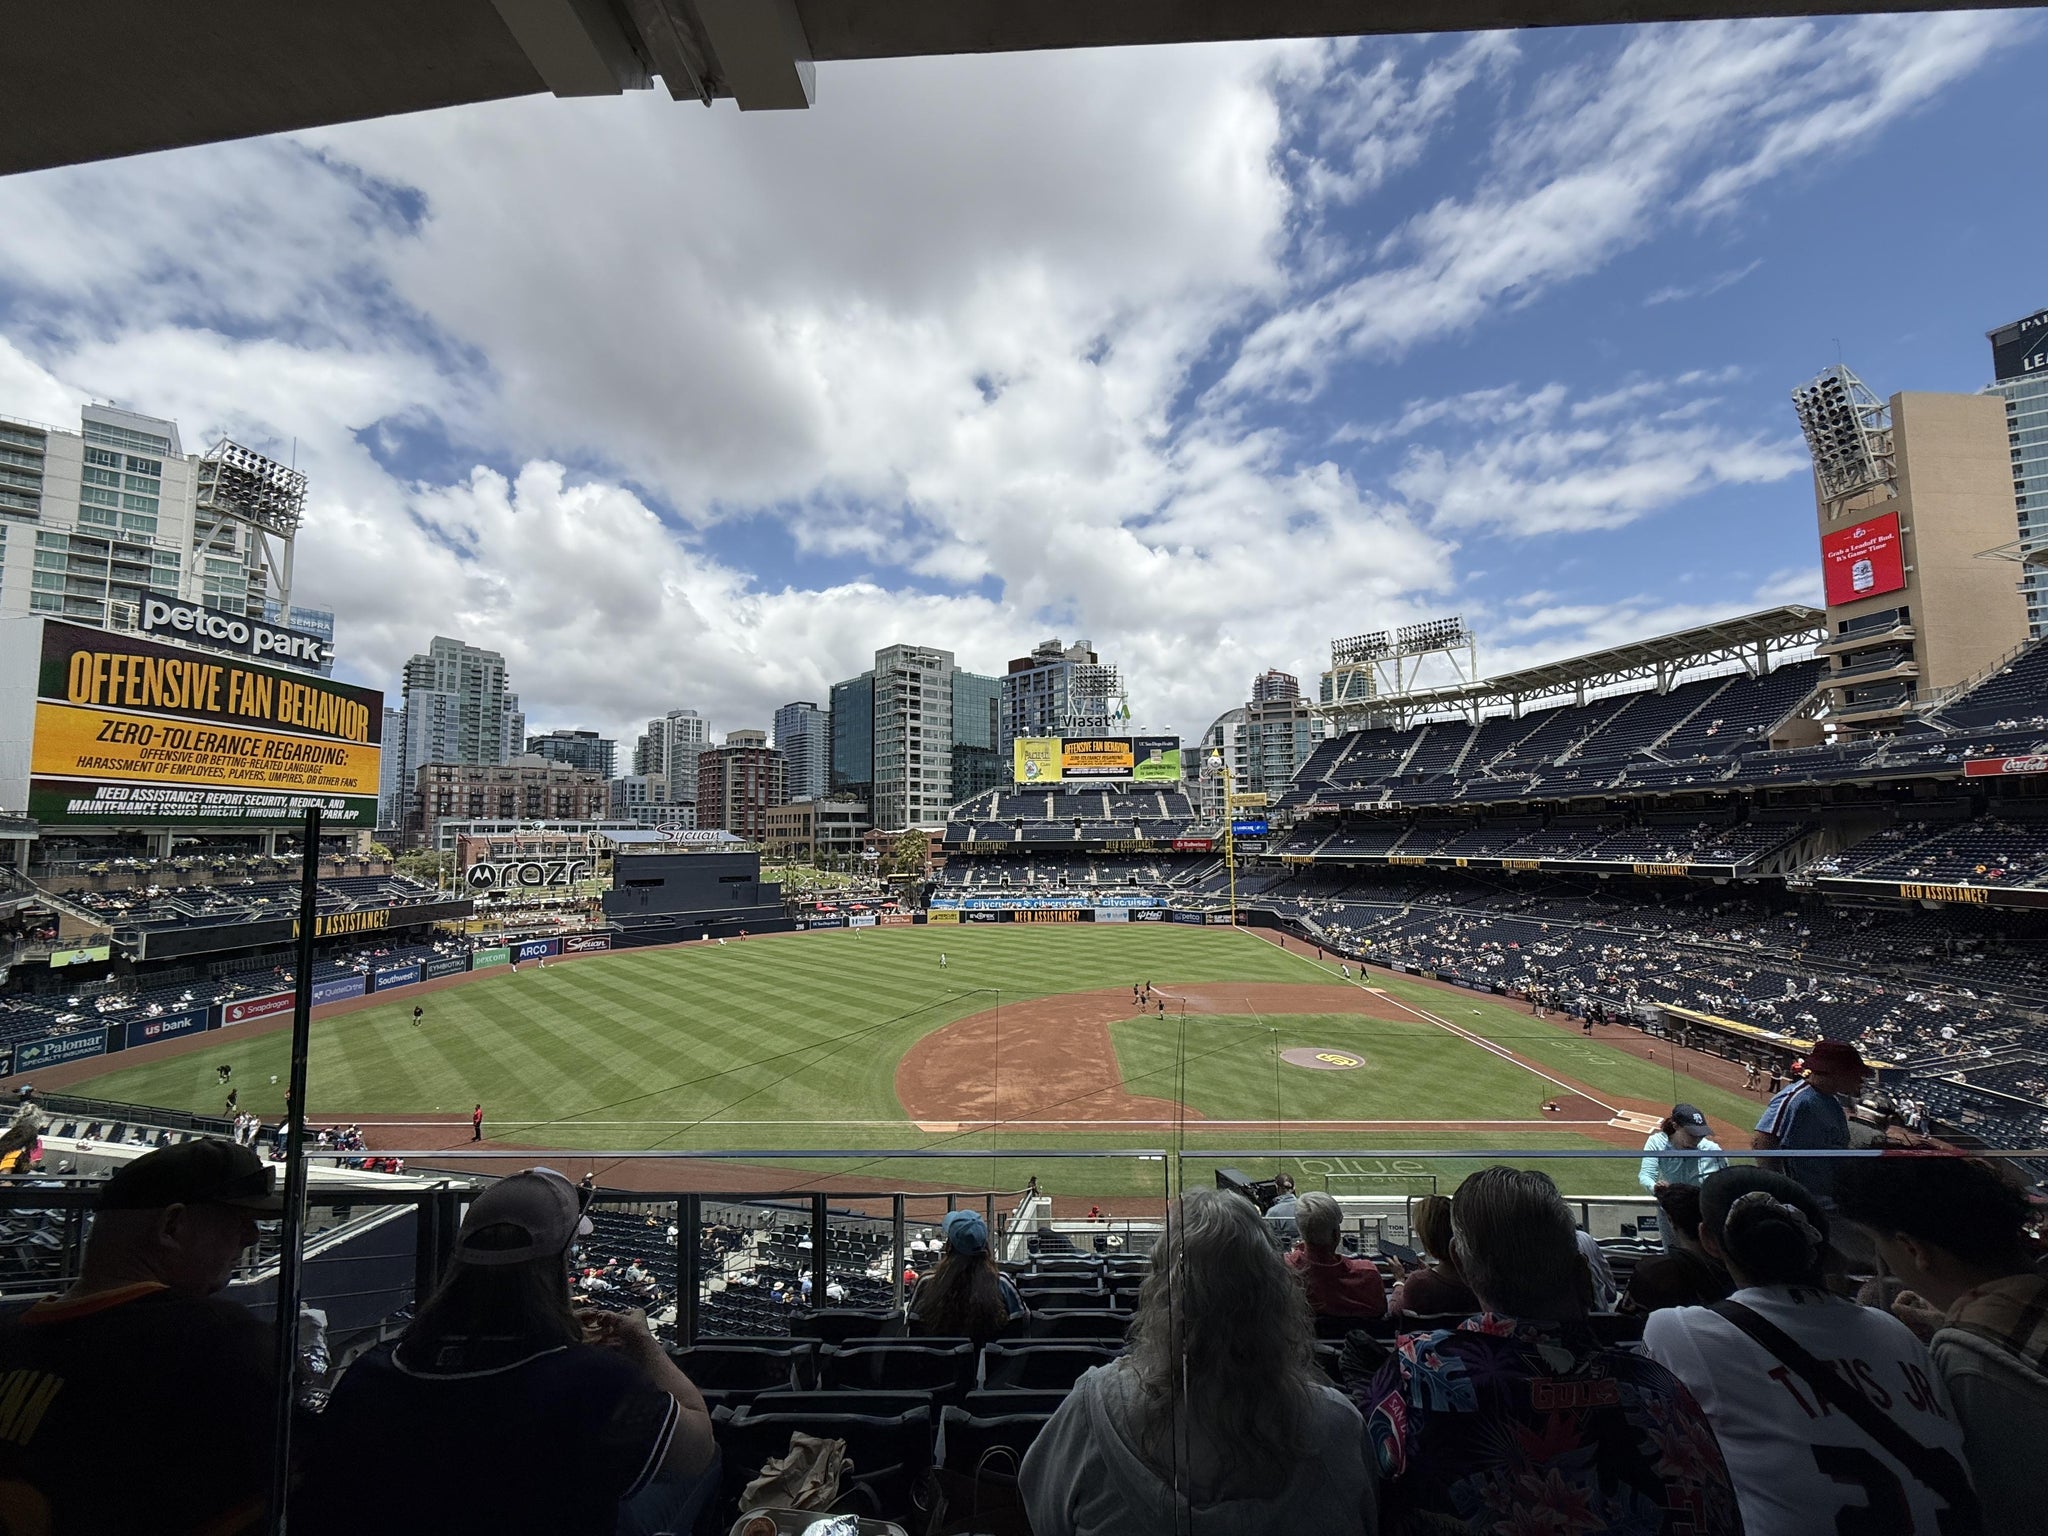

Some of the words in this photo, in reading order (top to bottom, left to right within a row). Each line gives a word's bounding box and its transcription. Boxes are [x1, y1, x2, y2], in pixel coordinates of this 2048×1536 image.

[1828, 549, 1844, 558] Grab
[1850, 537, 1877, 551] Leadoff
[1847, 549, 1868, 559] Game
[143, 599, 249, 644] petco
[252, 627, 321, 662] park
[290, 617, 331, 631] SEMPRA
[68, 650, 224, 712] OFFENSIVE
[228, 668, 273, 720] FAN
[278, 679, 369, 743] BEHAVIOR
[1062, 714, 1111, 728] Viasat
[96, 719, 262, 757] ZERO-TOLERANCE
[263, 740, 349, 766] REGARDING:
[1064, 740, 1092, 755] OFFENSIVE
[139, 748, 195, 763] OFFENSIVE
[195, 753, 209, 764] OR
[210, 754, 284, 771] BETTING-RELATED
[284, 761, 324, 774] LANGUAGE
[76, 756, 155, 773] HARASSMENT
[155, 762, 169, 774] OF
[170, 763, 227, 779] EMPLOYEES,
[229, 769, 266, 782] PLAYERS,
[268, 771, 305, 785] UMPIRES,
[306, 774, 317, 784] OR
[317, 775, 340, 787] OTHER
[340, 777, 358, 788] FANS
[95, 786, 130, 800] NEED
[130, 788, 205, 804] ASSISTANCE?
[205, 792, 245, 806] REPORT
[244, 793, 289, 808] SECURITY,
[289, 796, 327, 809] MEDICAL,
[328, 799, 346, 809] AND
[67, 800, 157, 816] MAINTENANCE
[157, 802, 198, 816] ISSUES
[198, 804, 244, 818] DIRECTLY
[245, 806, 286, 818] THROUGH
[287, 808, 302, 818] THE
[343, 810, 360, 820] APP
[655, 821, 720, 847] Sycuan
[499, 861, 587, 888] razr
[1633, 864, 1647, 874] NEED
[1648, 864, 1689, 876] ASSISTANCE?
[1900, 883, 1922, 899] NEED
[1925, 885, 1988, 903] ASSISTANCE?
[292, 915, 322, 939] ND
[325, 909, 391, 936] ASSISTANCE?
[1014, 911, 1032, 923] NEED
[1034, 911, 1080, 923] ASSISTANCE?
[519, 944, 548, 958] ARCO
[566, 937, 606, 952] Sycuan
[378, 973, 414, 986] Southwest
[247, 999, 289, 1014] Snapdragon
[162, 1017, 193, 1033] bank
[43, 1035, 103, 1057] Palomar
